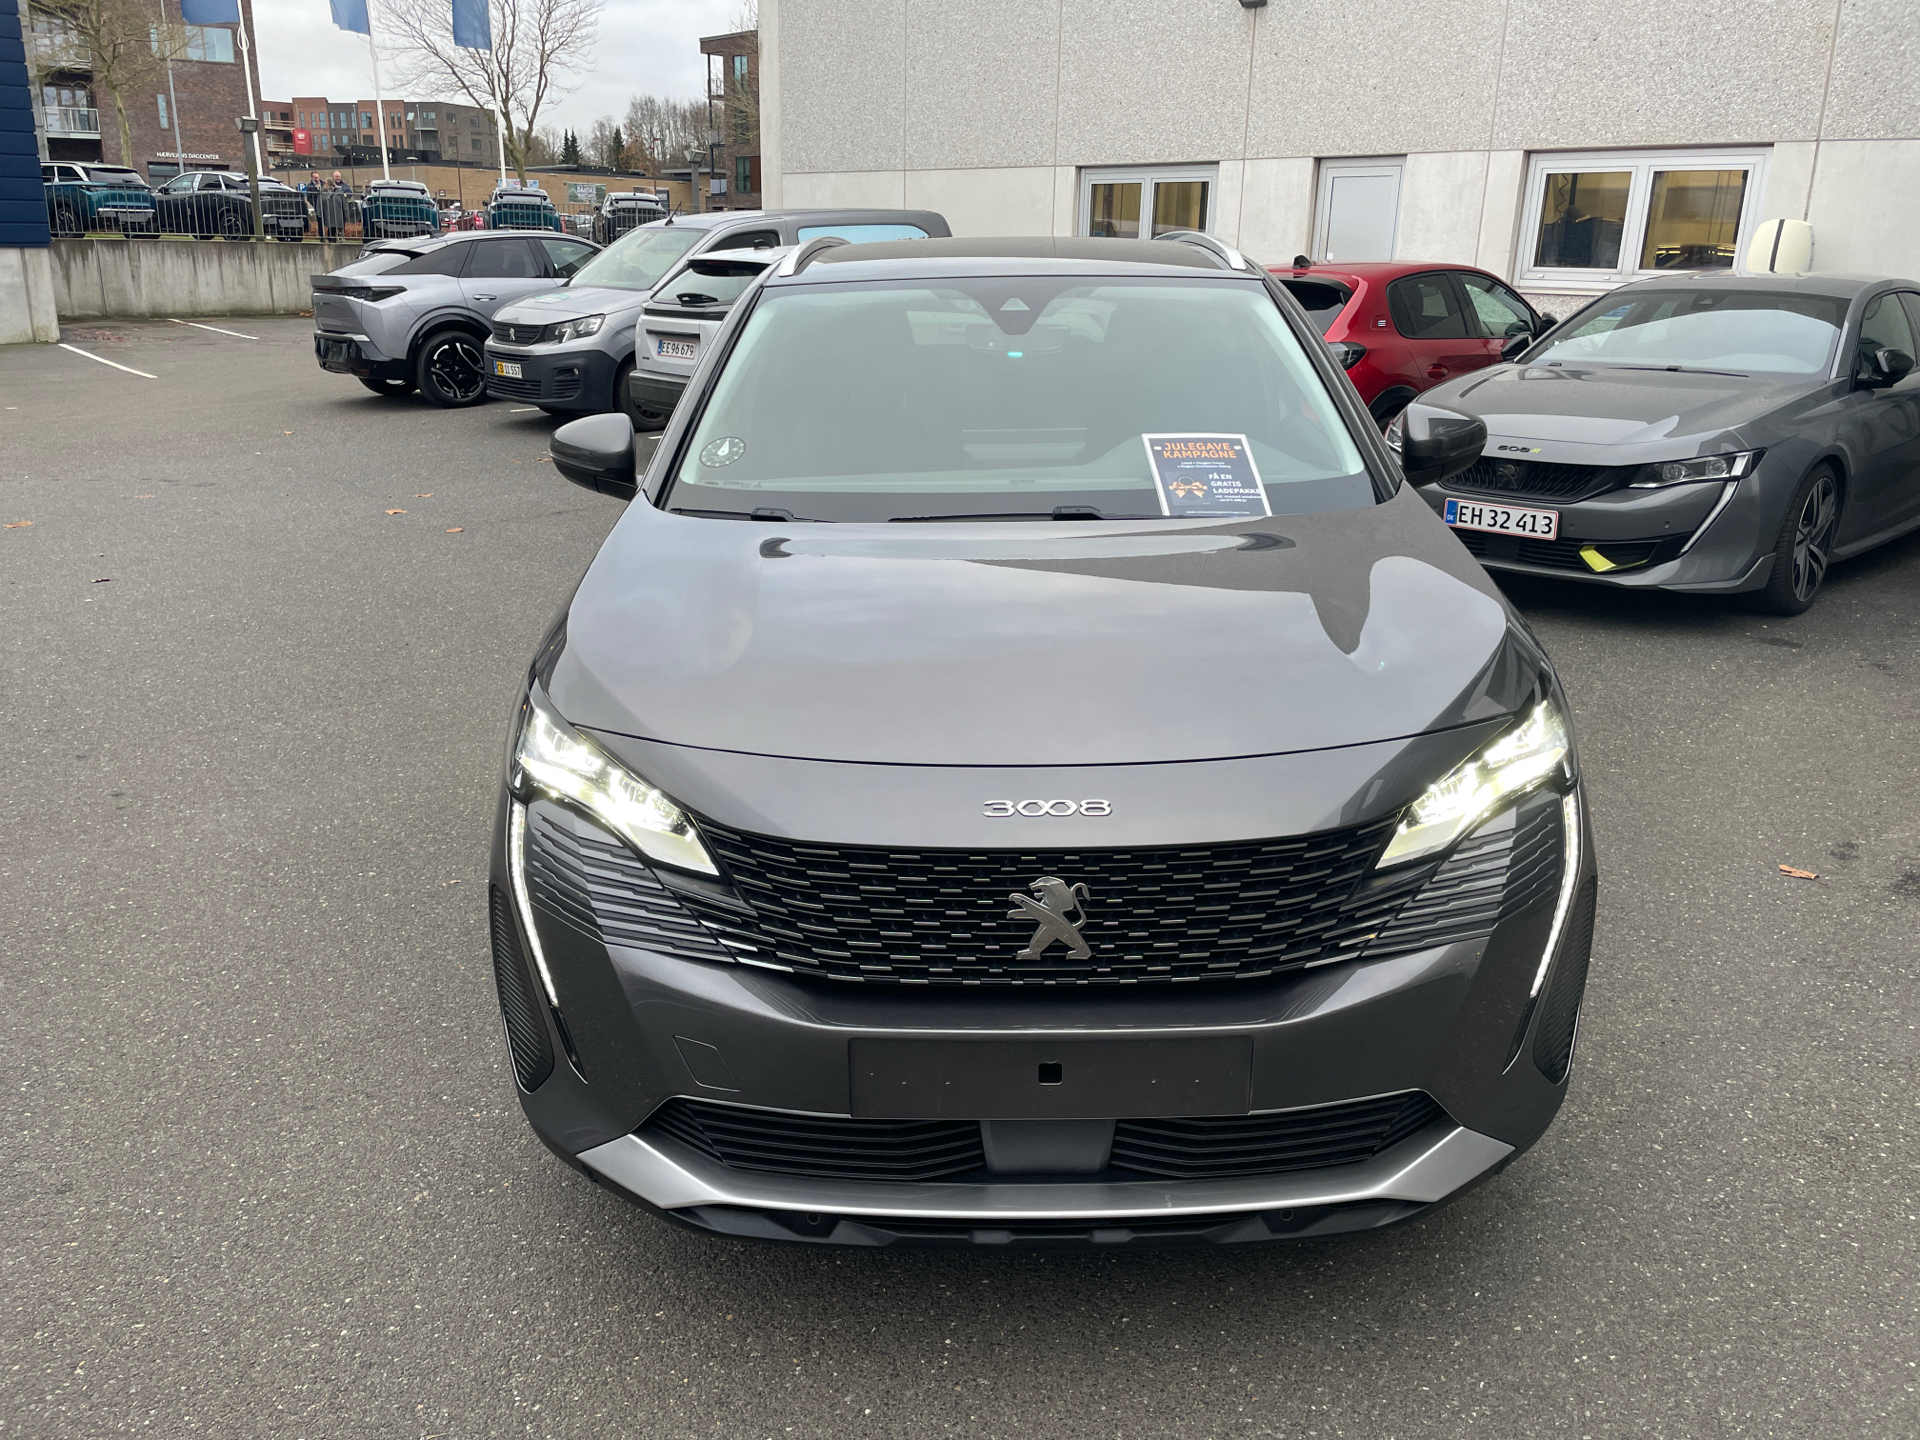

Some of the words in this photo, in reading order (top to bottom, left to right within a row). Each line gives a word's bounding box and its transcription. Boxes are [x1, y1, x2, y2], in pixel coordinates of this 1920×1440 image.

[661, 341, 671, 354] EE
[671, 343, 680, 355] 96
[680, 344, 695, 356] 679
[510, 365, 520, 376] 557
[1164, 442, 1231, 451] JULEGAVE
[1163, 450, 1237, 459] KAMPAGNE
[1208, 472, 1220, 480] FÅ
[1458, 505, 1483, 526] EH
[1487, 509, 1511, 530] 32
[1515, 513, 1553, 535] 413
[982, 799, 1113, 817] 3008
